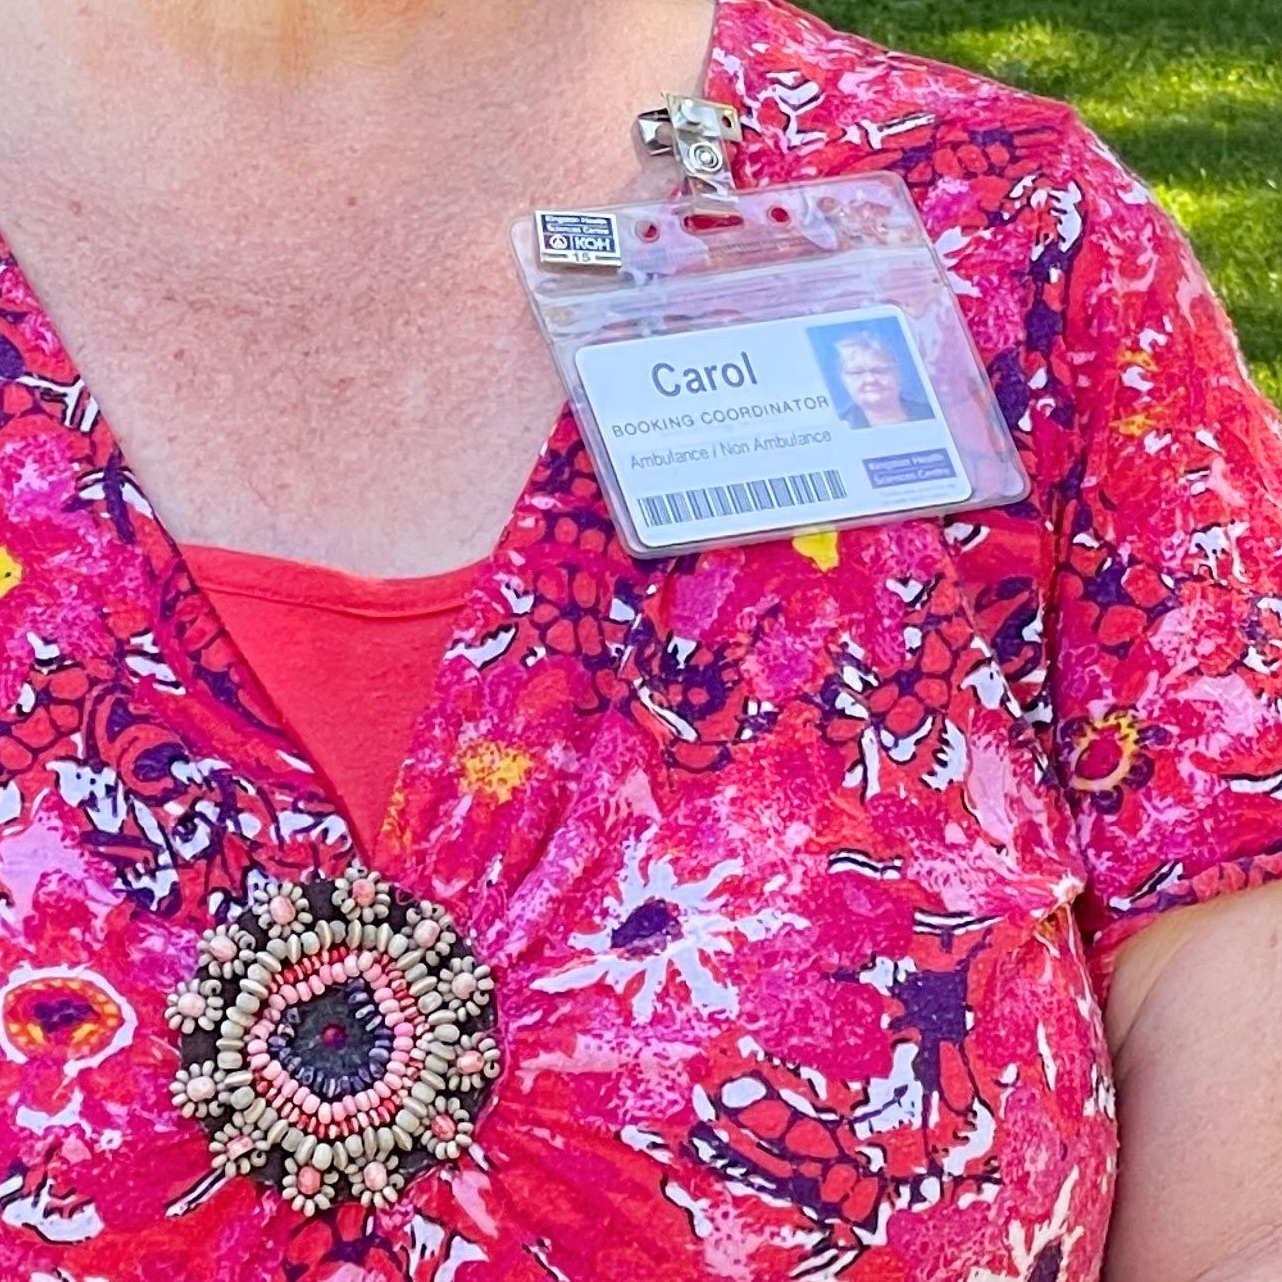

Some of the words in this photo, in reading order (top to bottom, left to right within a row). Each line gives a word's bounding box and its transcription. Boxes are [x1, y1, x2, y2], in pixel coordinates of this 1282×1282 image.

[651, 351, 758, 398] Carol
[612, 414, 695, 438] BOOKING
[701, 395, 830, 426] COORDINATOR
[630, 447, 711, 470] Ambulance
[719, 442, 751, 457] Non
[754, 429, 832, 453] Ambulance
